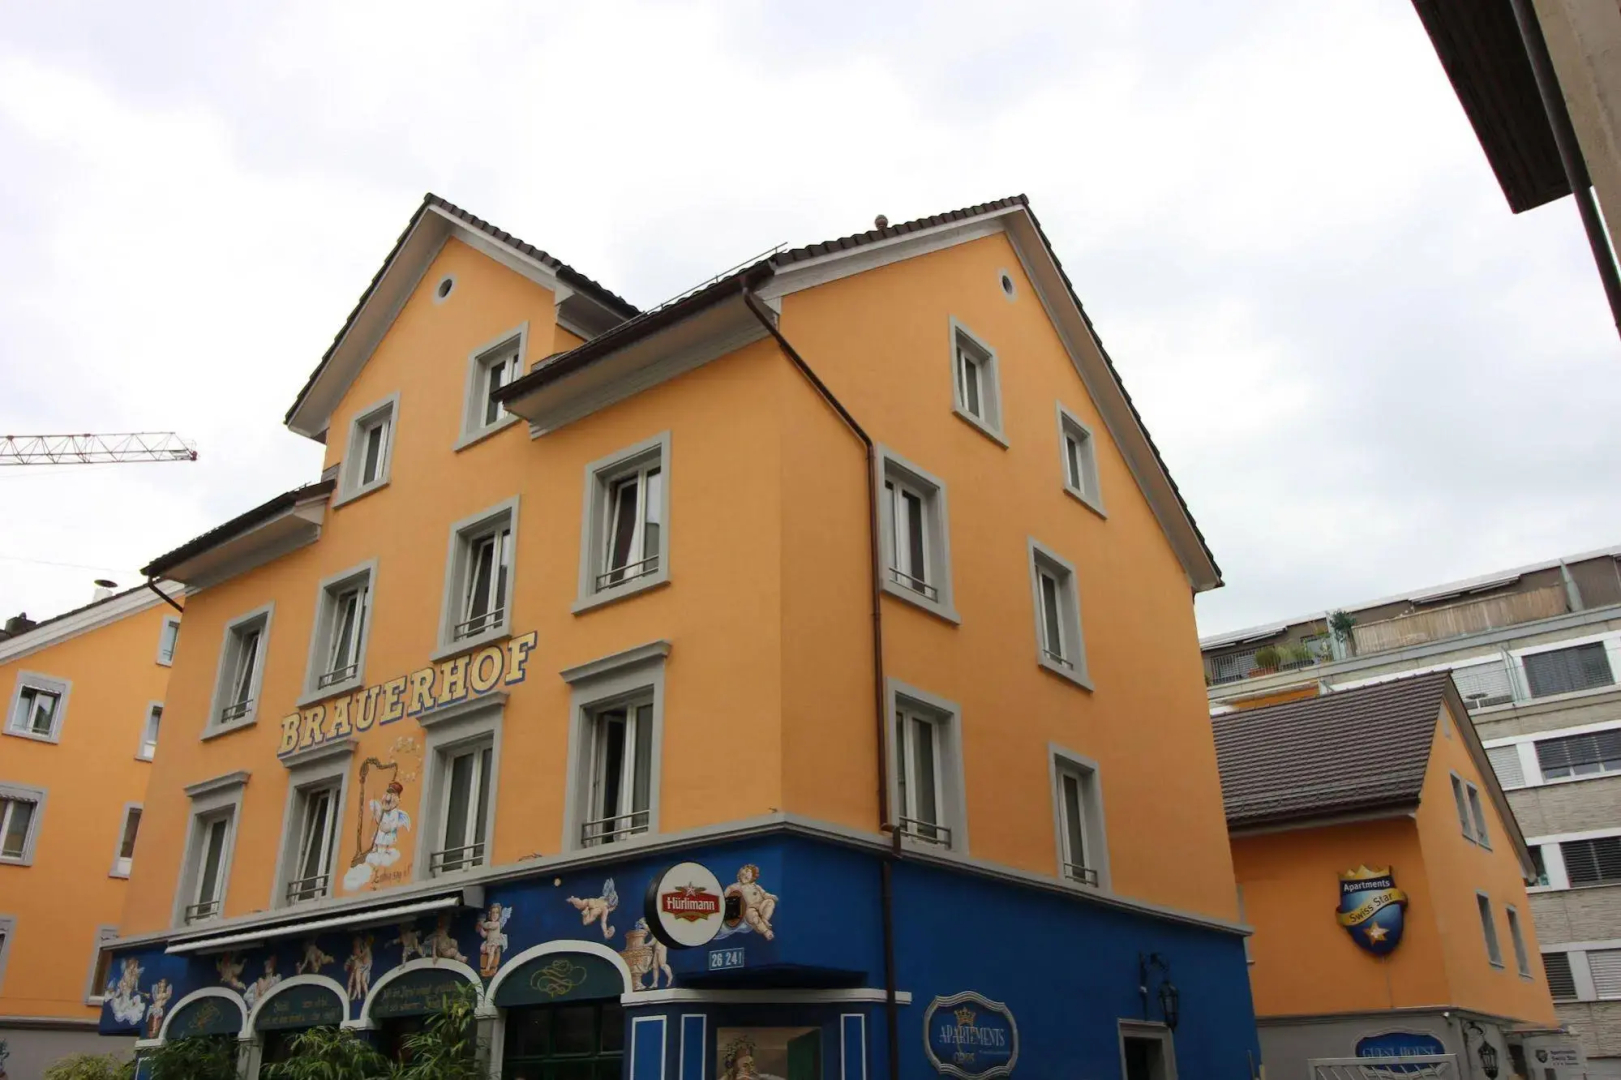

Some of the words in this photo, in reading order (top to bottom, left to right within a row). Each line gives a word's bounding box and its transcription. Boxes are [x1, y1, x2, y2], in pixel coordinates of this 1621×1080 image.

[277, 630, 538, 757] BRAUERHOF
[1343, 879, 1391, 893] Apartments
[666, 896, 715, 910] Hürlimann
[1349, 904, 1374, 923] Swiss
[1372, 892, 1394, 907] Star
[711, 952, 723, 967] 26
[938, 1024, 1006, 1047] APARTEMENTS
